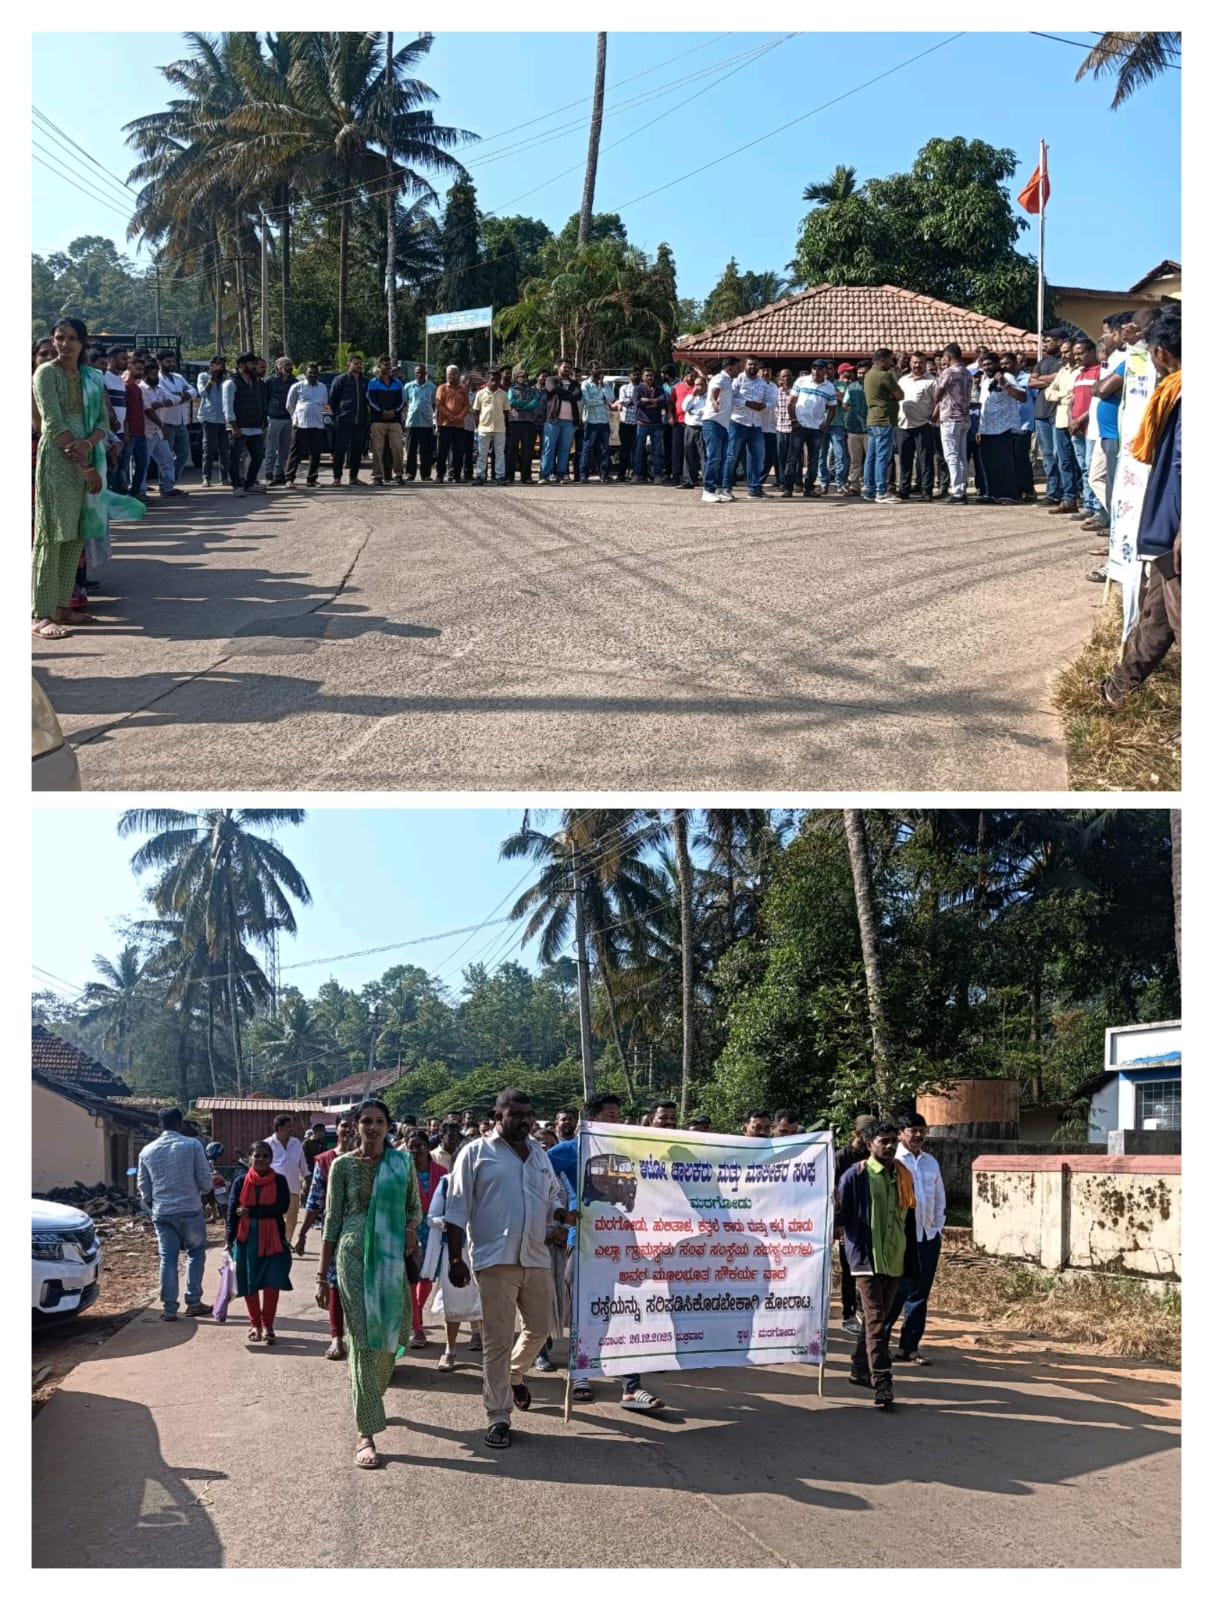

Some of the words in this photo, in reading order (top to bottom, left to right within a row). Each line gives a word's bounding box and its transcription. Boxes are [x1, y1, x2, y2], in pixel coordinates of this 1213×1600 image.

[716, 1160, 742, 1192] ಮತ್ತು
[792, 1159, 816, 1186] ಸಂಘ
[689, 1195, 752, 1210] ಮರಗೋಡು
[594, 1215, 649, 1232] ಮರಗೋಡು,
[594, 1245, 620, 1262] ಎಲ್ಲಾ
[679, 1242, 706, 1257] ಸಂಘ
[619, 1267, 648, 1282] ಅವರ
[652, 1266, 710, 1282] ಮೂಲಭೂತ
[590, 1295, 641, 1323] ರಸ್ತೆಯನ್ನು
[645, 1291, 760, 1313] ಸರಿಪಡಿಸಿಕೊಡಬೇಕಾಗಿ
[764, 1291, 814, 1310] ಹೋರಾಟ.
[629, 1331, 673, 1345] 26.12.2025
